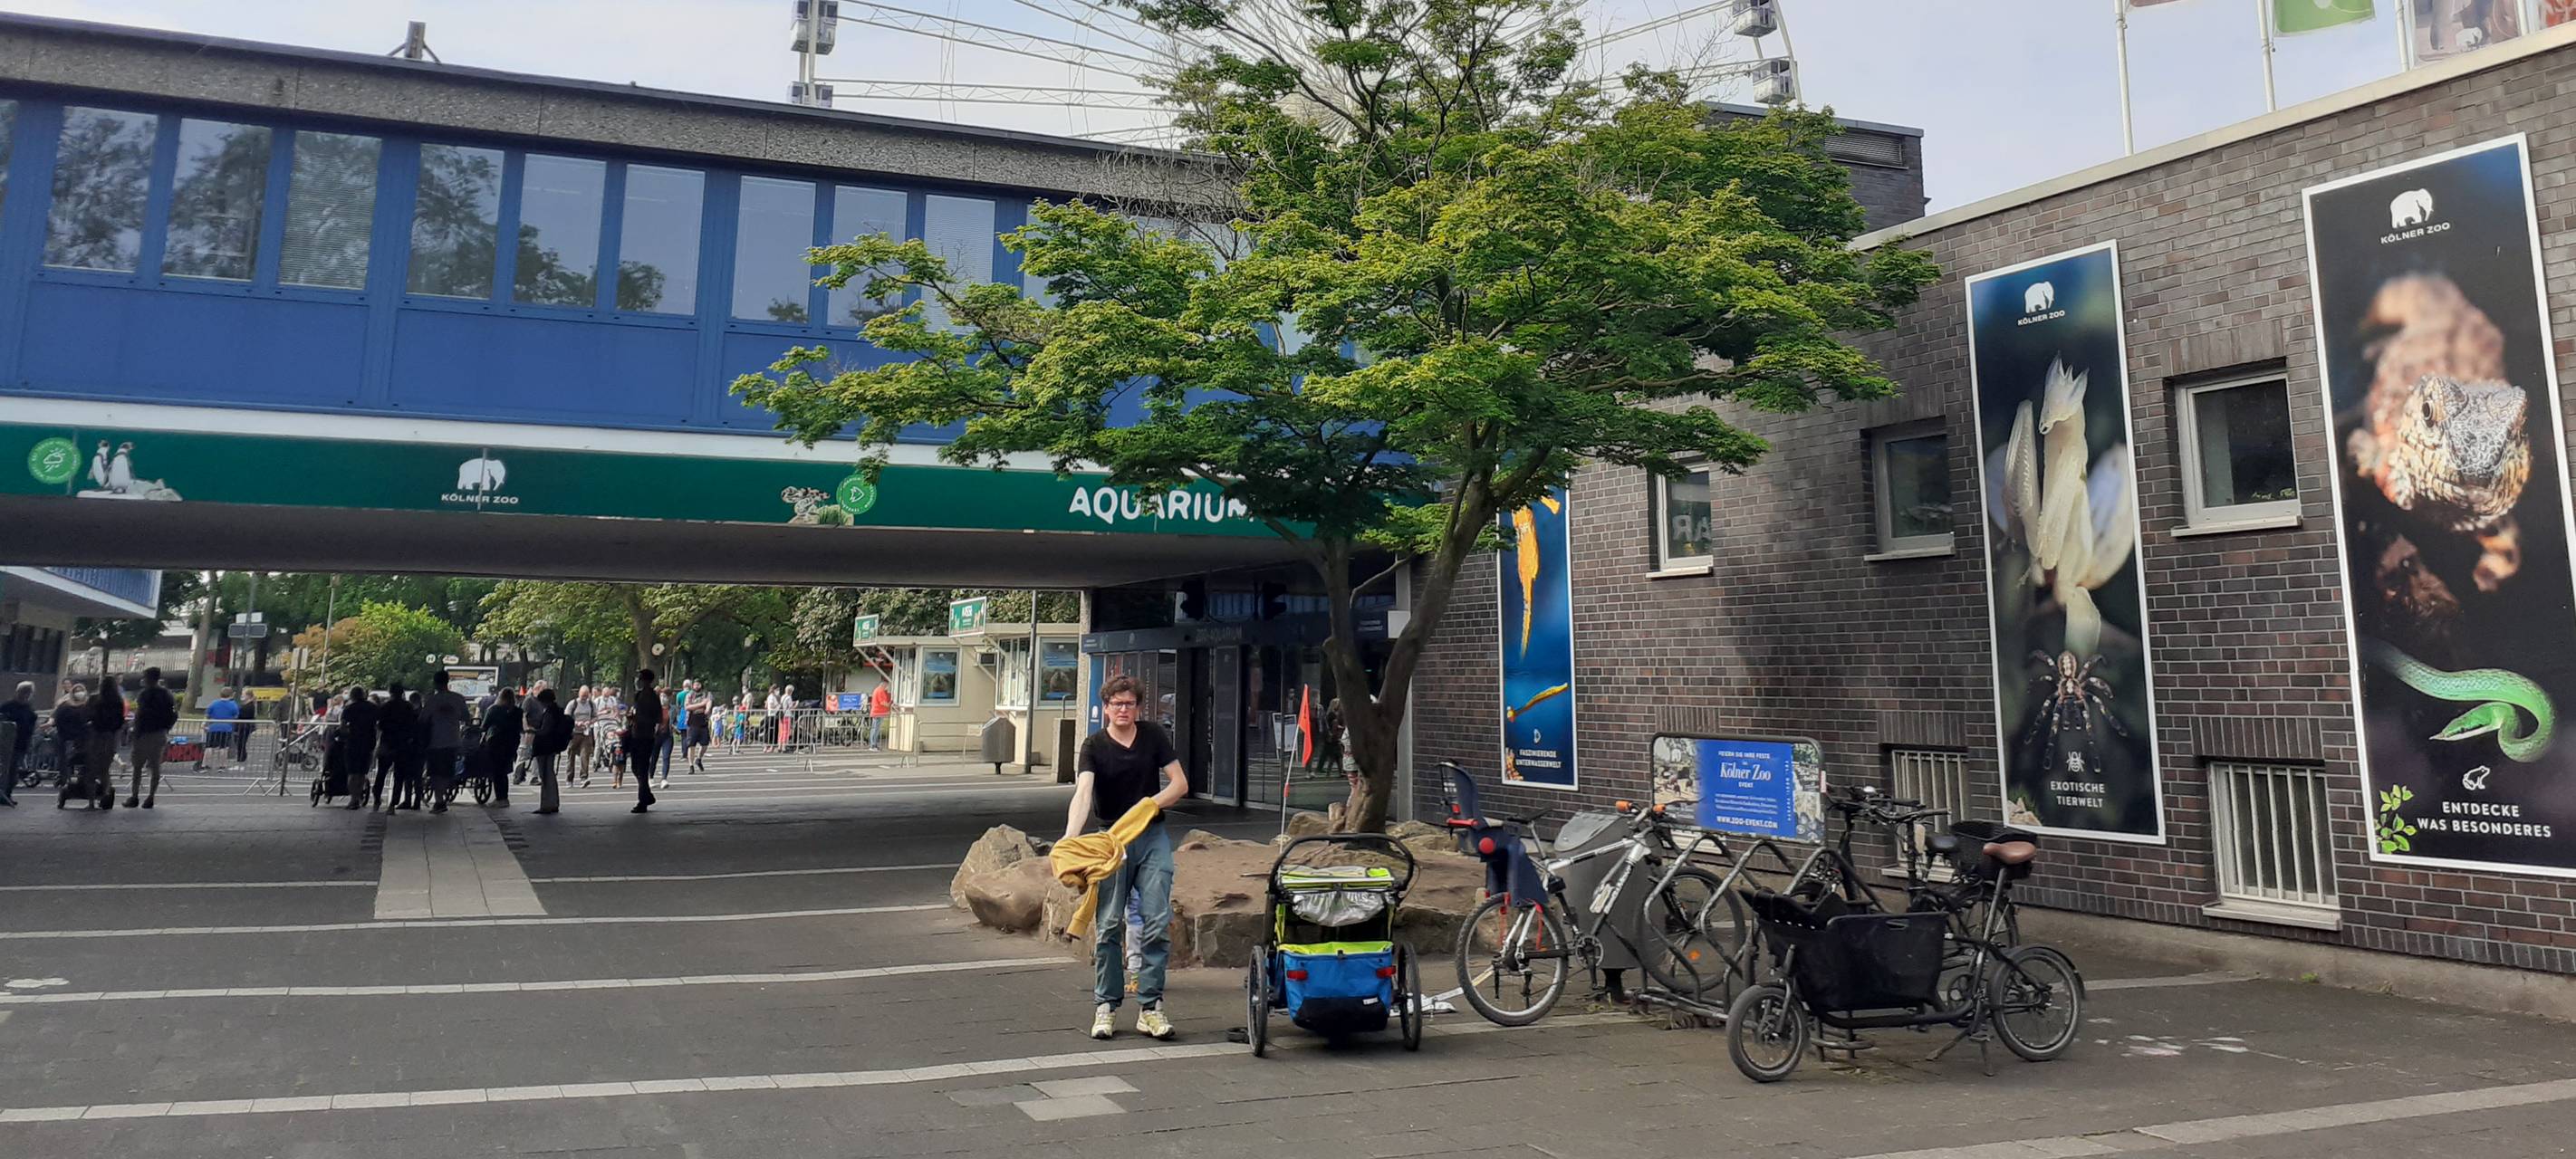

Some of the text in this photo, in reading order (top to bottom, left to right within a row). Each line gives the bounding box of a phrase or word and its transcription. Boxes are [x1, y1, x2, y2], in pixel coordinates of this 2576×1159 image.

[2380, 222, 2451, 244] KÖLNER ZOO
[2017, 310, 2065, 326] KÖLNER ZOO
[441, 493, 519, 504] KÖLNER ZOO
[1752, 763, 1772, 781] Zoo
[2050, 781, 2106, 793] EXOTISCHE
[2056, 795, 2103, 808] TIERWELT
[2442, 801, 2521, 818] ENTDECKE
[2417, 818, 2552, 838] WAS BESONDERES
